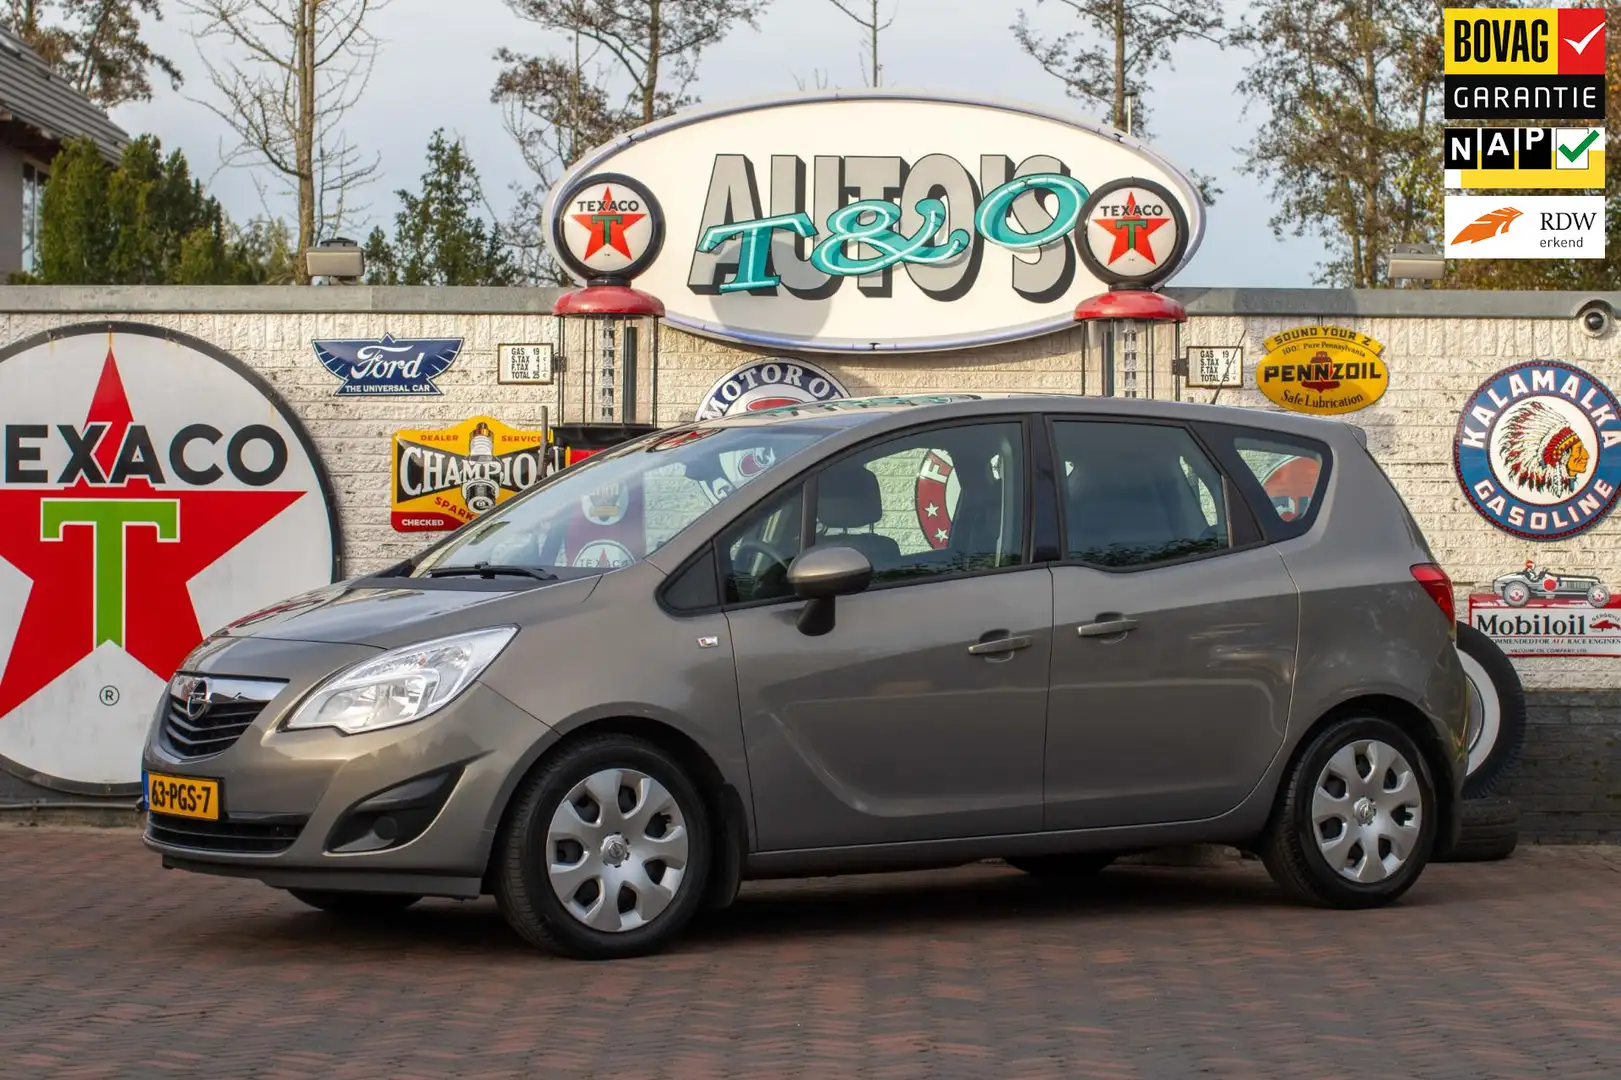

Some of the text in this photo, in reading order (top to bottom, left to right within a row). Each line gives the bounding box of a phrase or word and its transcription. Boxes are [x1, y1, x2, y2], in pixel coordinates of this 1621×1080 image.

[577, 200, 640, 213] TEXACO
[1100, 204, 1163, 217] TEXACO
[1274, 328, 1372, 346] SOUND YOUR Z
[511, 347, 525, 356] GAS
[1200, 350, 1214, 358] GAS
[1222, 350, 1229, 358] 19
[1321, 341, 1366, 358] Pennsylvania
[351, 344, 425, 381] Ford
[511, 371, 531, 379] TOTAL
[1200, 374, 1220, 382] TOTAL
[1264, 362, 1382, 383] PENNZOIL
[345, 384, 431, 393] THE UNIVERSAL CAR
[701, 363, 804, 419] MOTOR
[1281, 389, 1364, 408] Safe Lubrication
[1461, 369, 1621, 449] KALAMALKA
[420, 434, 459, 442] DEALER
[5, 423, 289, 487] EXACO
[434, 496, 475, 521] SPARK
[1473, 478, 1615, 530] GASOLINE
[401, 519, 445, 527] CHECKED
[1476, 614, 1586, 635] Mobiloil
[151, 779, 212, 813] 63-PGS-7
